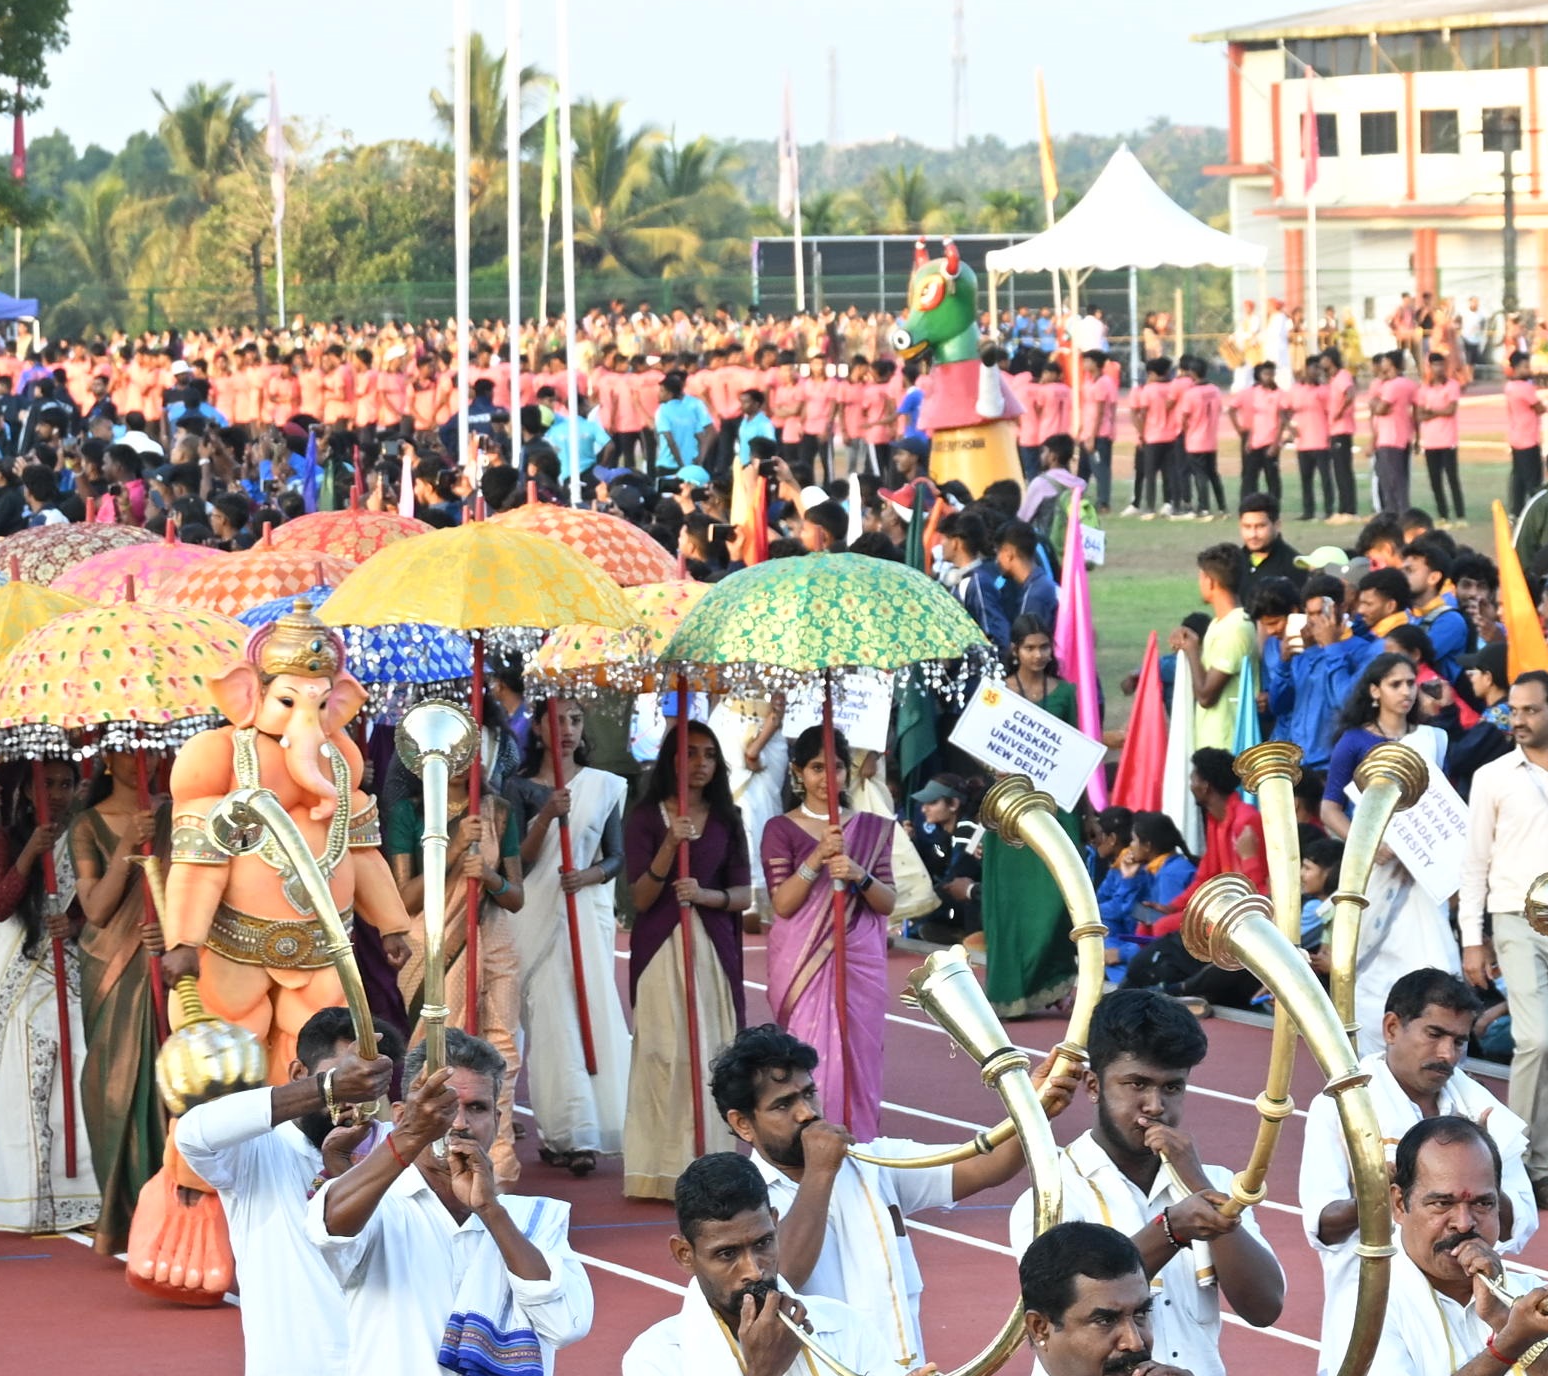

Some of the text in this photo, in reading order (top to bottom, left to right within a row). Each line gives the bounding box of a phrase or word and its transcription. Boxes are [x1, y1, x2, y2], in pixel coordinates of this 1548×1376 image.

[983, 690, 999, 704] 35
[1002, 719, 1060, 756] SANSKRIT
[1012, 710, 1063, 746] CENTRAL
[986, 741, 1049, 782] NEW DELHI
[990, 728, 1058, 771] UNIVERSITY
[1405, 811, 1437, 850] ANDAL
[1419, 801, 1452, 840] RAYAN
[1427, 785, 1467, 837] UPENDR
[1392, 816, 1434, 868] VERSITY
